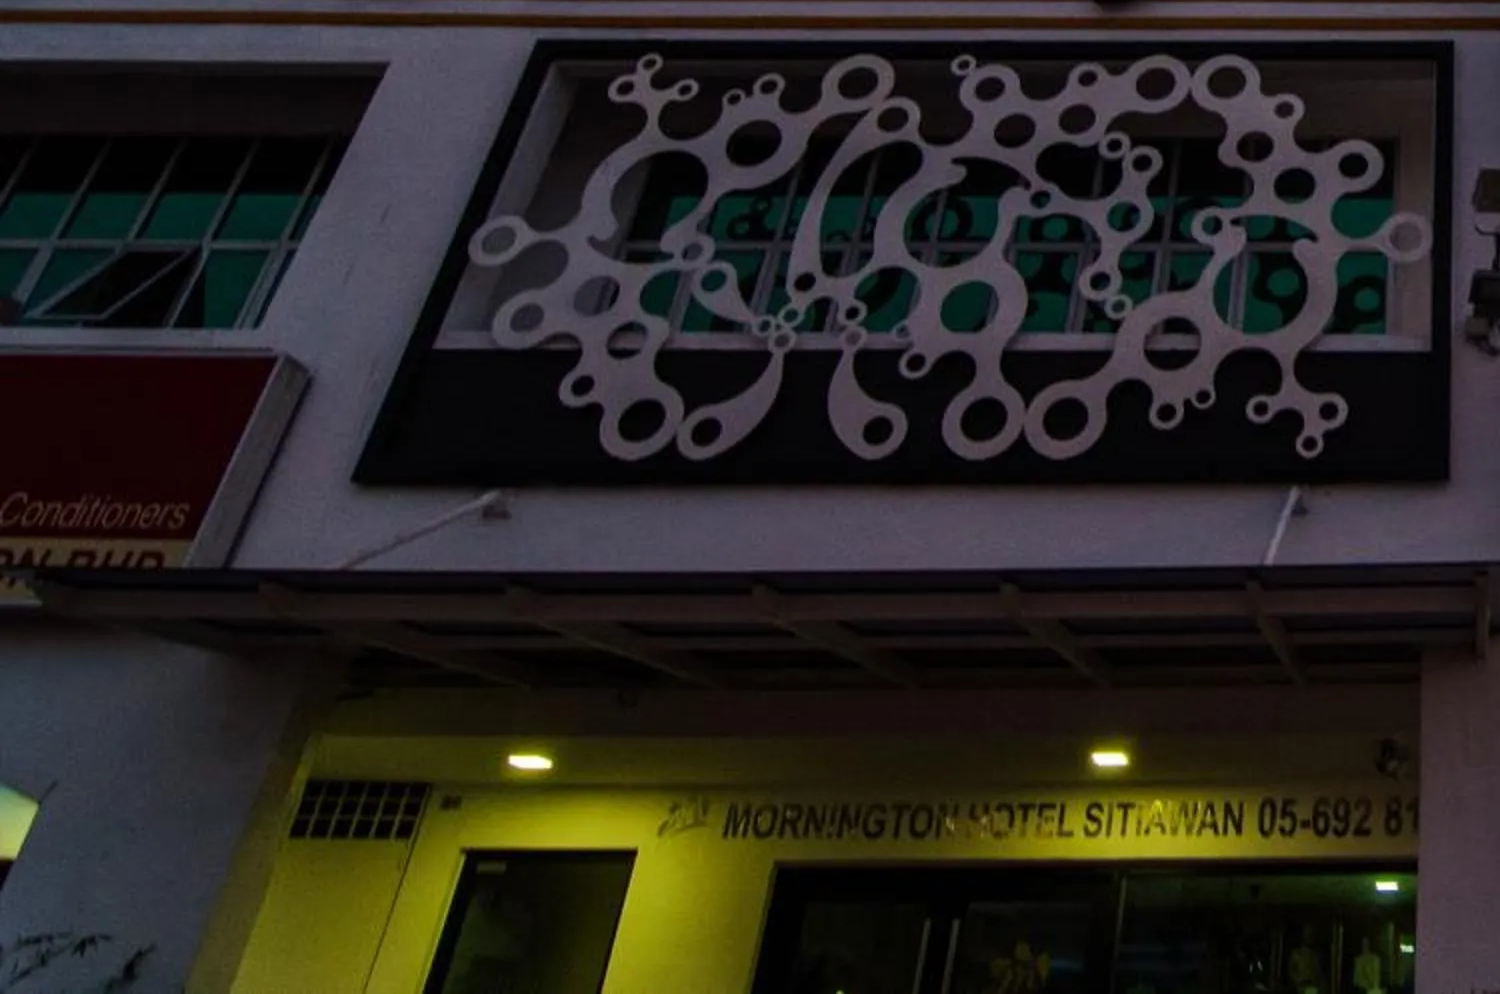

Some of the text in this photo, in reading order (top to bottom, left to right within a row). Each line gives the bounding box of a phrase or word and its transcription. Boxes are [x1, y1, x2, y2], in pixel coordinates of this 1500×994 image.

[0, 490, 191, 530] Conditioners
[721, 802, 960, 840] MORNINGTON
[1257, 796, 1373, 839] 05-692
